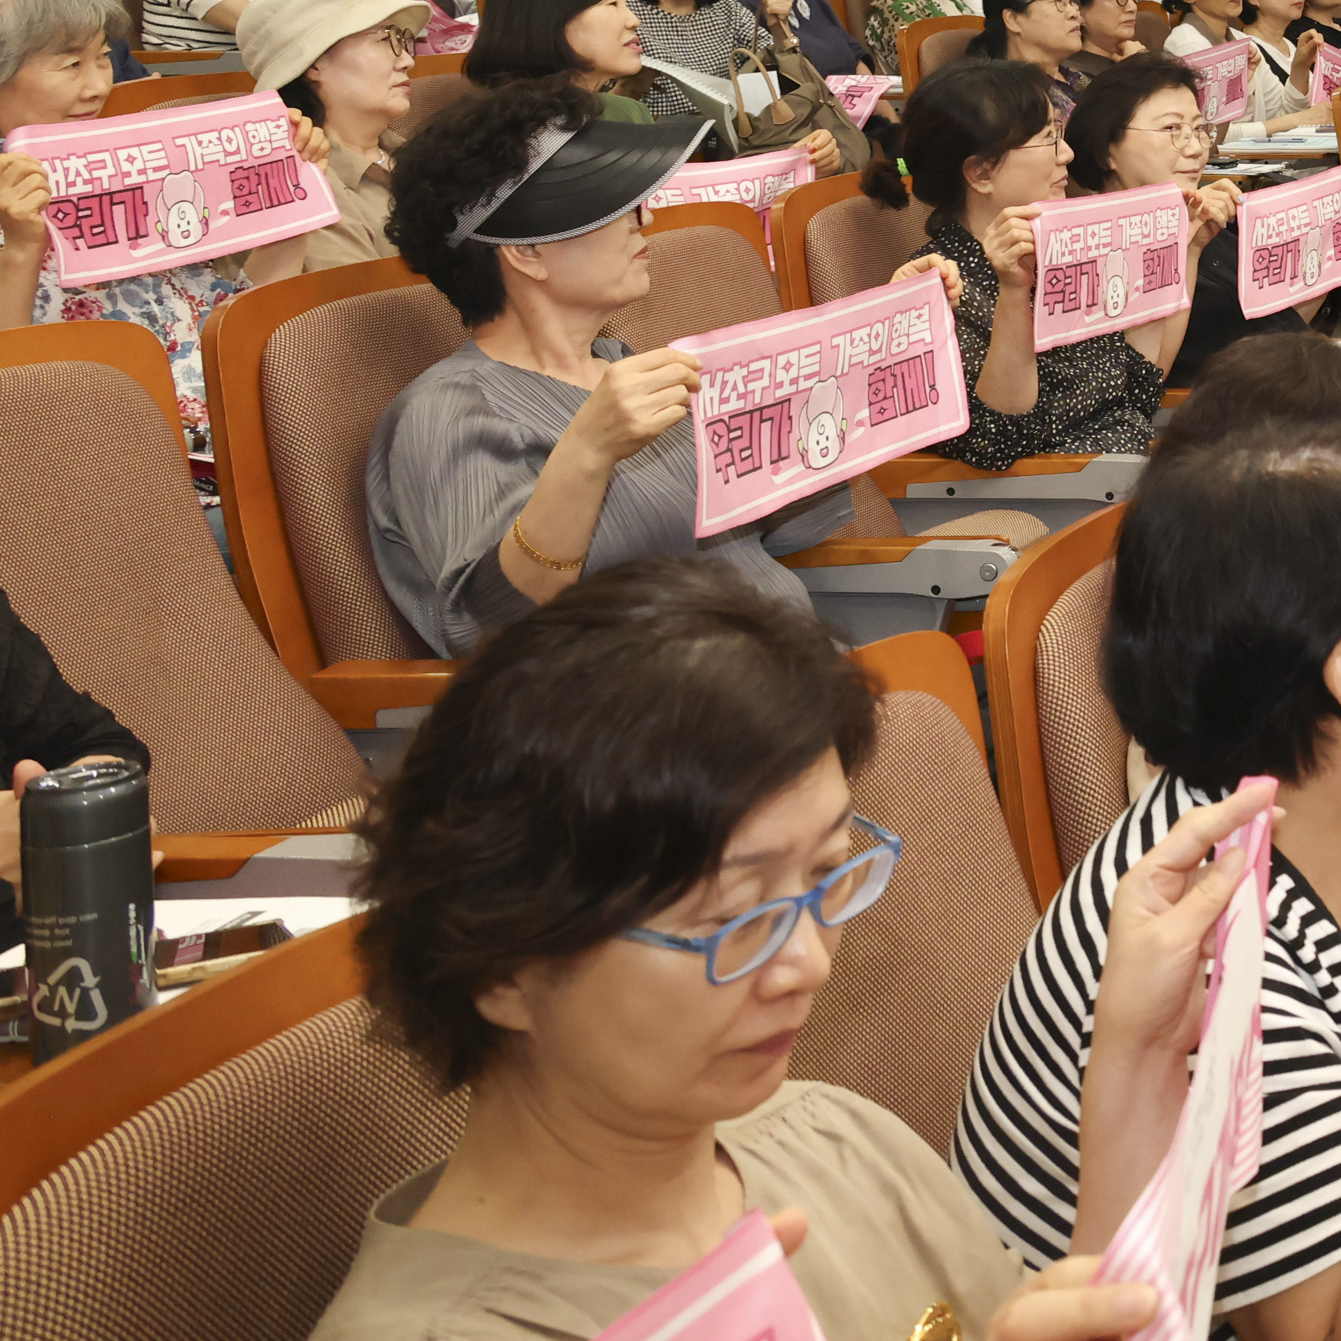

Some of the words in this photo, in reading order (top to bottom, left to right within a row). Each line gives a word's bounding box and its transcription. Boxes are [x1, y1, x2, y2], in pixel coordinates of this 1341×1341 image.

[117, 142, 170, 185] 모든
[174, 127, 247, 170] 가족의
[246, 118, 291, 157] 행복
[47, 186, 149, 251] 우리가
[230, 155, 307, 217] 함께!
[1044, 226, 1085, 266] 서초구
[1086, 220, 1112, 258] 모든
[1118, 212, 1154, 250] 가족의
[1155, 206, 1180, 243] 행복
[1251, 211, 1288, 249] 서초구
[1288, 203, 1312, 238] 모든
[1044, 260, 1099, 316] 우리가
[1143, 242, 1180, 294] 함께!
[1252, 238, 1300, 290] 우리가
[700, 356, 772, 420] 서초구
[775, 341, 821, 398] 모든
[831, 318, 889, 376] 가족의
[890, 303, 932, 355] 행복
[705, 399, 792, 484] 우리가
[868, 350, 939, 427] 함께!
